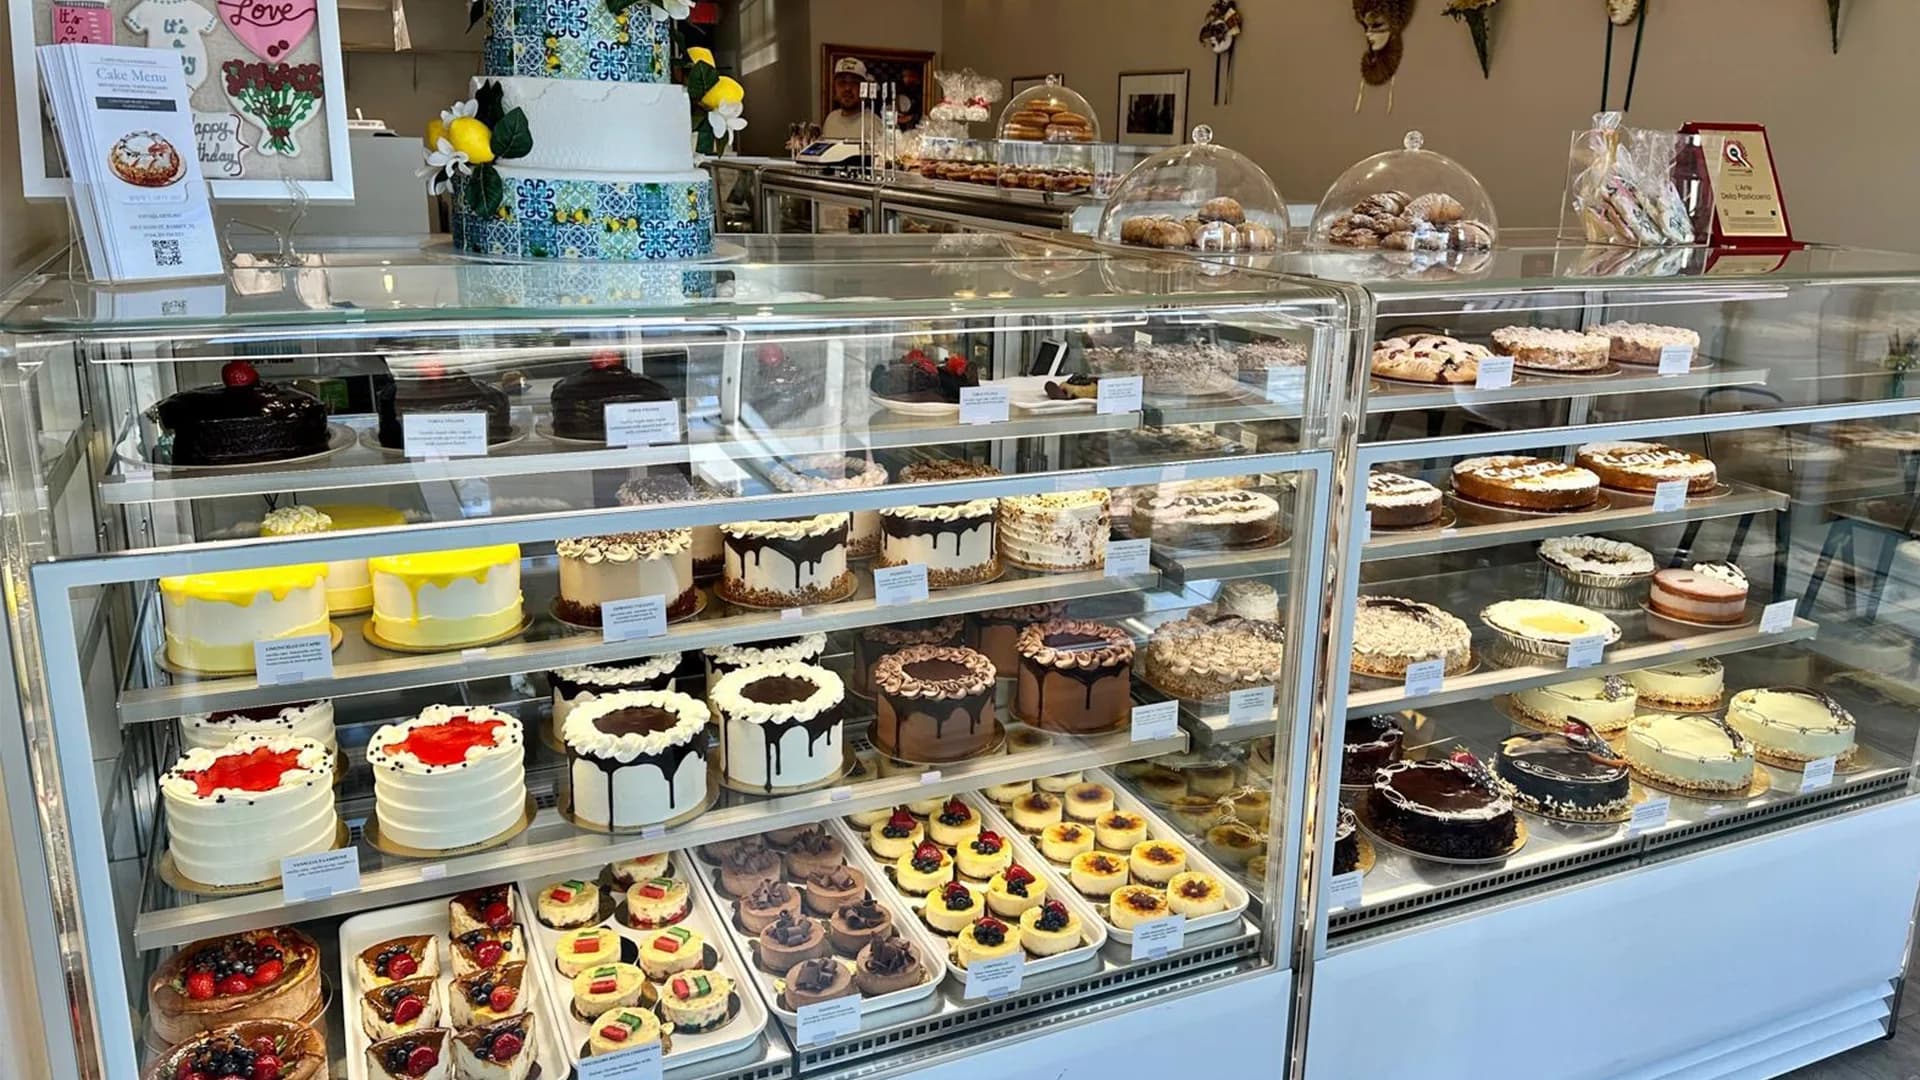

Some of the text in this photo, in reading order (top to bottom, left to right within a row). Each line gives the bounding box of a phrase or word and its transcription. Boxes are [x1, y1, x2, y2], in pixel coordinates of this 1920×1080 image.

[60, 8, 83, 25] It's
[226, 0, 300, 26] Love
[65, 25, 77, 35] a
[163, 18, 188, 34] It's
[172, 38, 186, 48] a
[96, 67, 167, 82] Cake Menu
[192, 113, 234, 141] appy
[197, 143, 239, 172] thday
